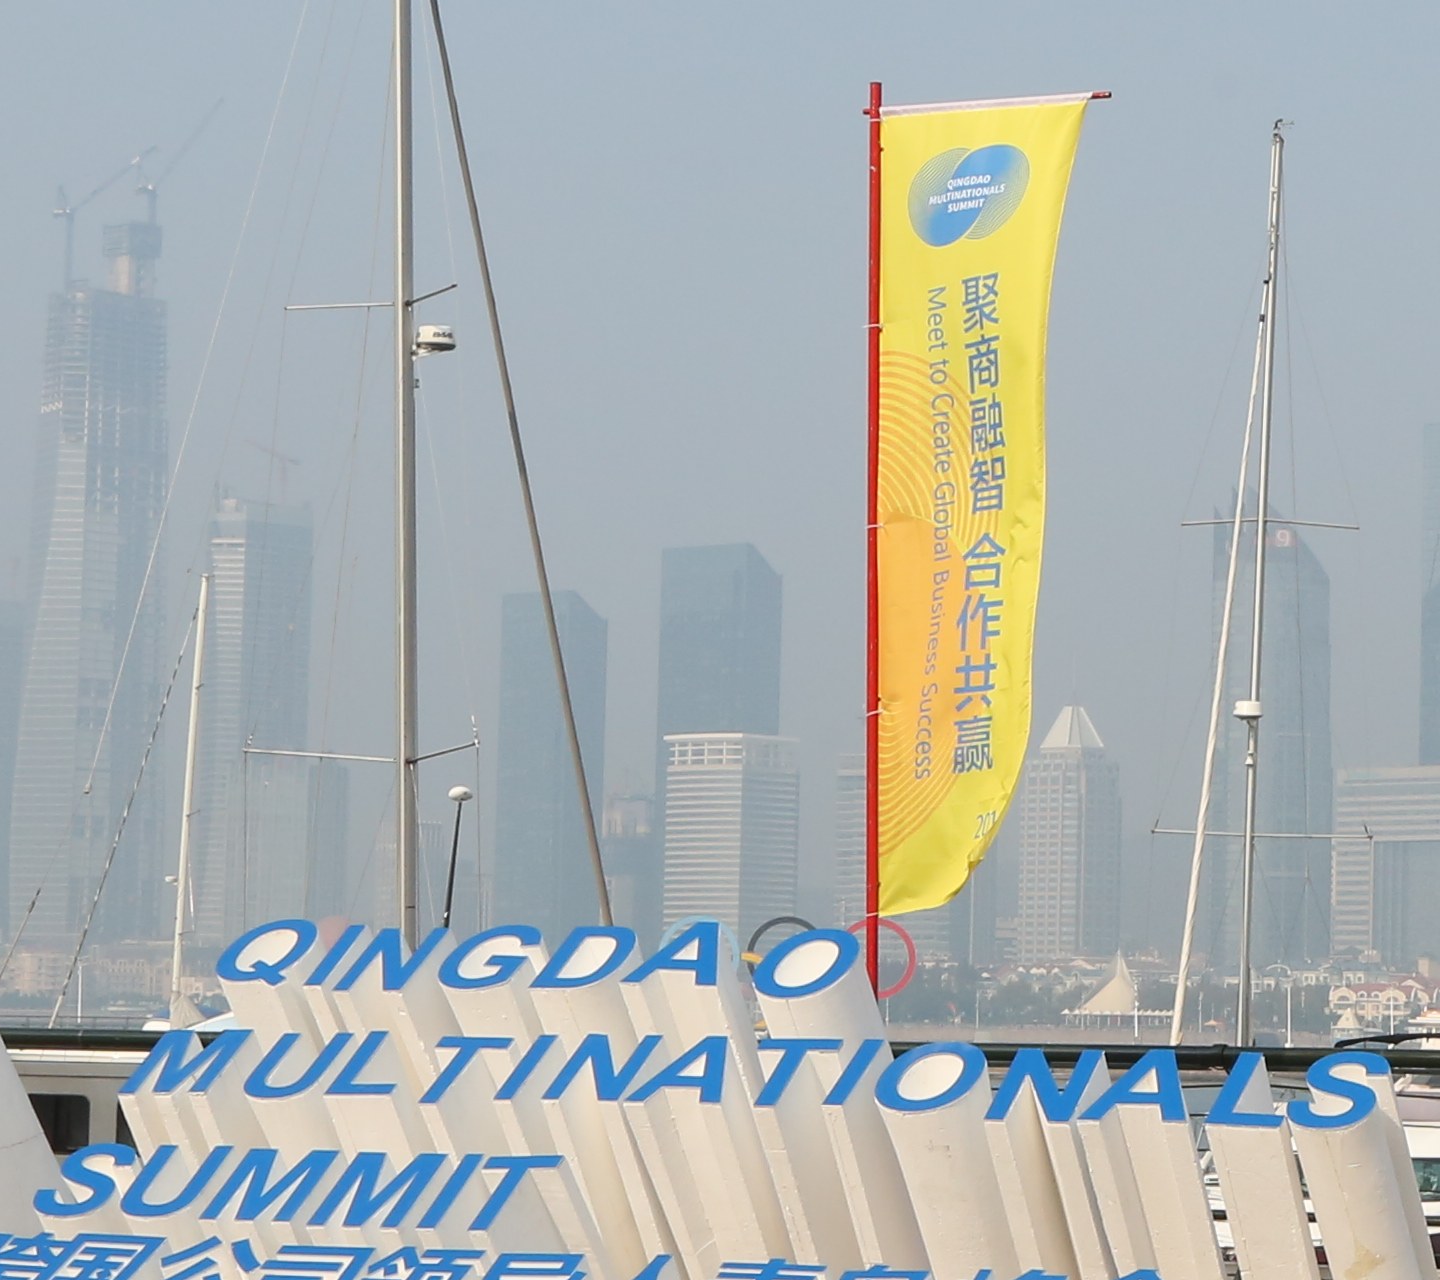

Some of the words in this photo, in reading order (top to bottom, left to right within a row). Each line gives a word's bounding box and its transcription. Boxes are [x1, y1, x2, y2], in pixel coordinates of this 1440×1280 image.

[928, 183, 1006, 205] MULTINATIONALS
[946, 174, 991, 190] QINGDAO
[947, 198, 985, 213] SUMMIT
[927, 285, 947, 352] Meet
[929, 356, 951, 385] to
[961, 272, 1006, 515] 聚商融智
[931, 392, 955, 474] Create
[933, 480, 956, 561] Global
[924, 570, 951, 675] Business
[951, 532, 1006, 774] 合作共赢
[915, 682, 939, 780] Success
[216, 919, 860, 998] QINGDAO
[118, 1029, 1391, 1128] MULTINATIONALS
[32, 1143, 564, 1231] SUMMIT
